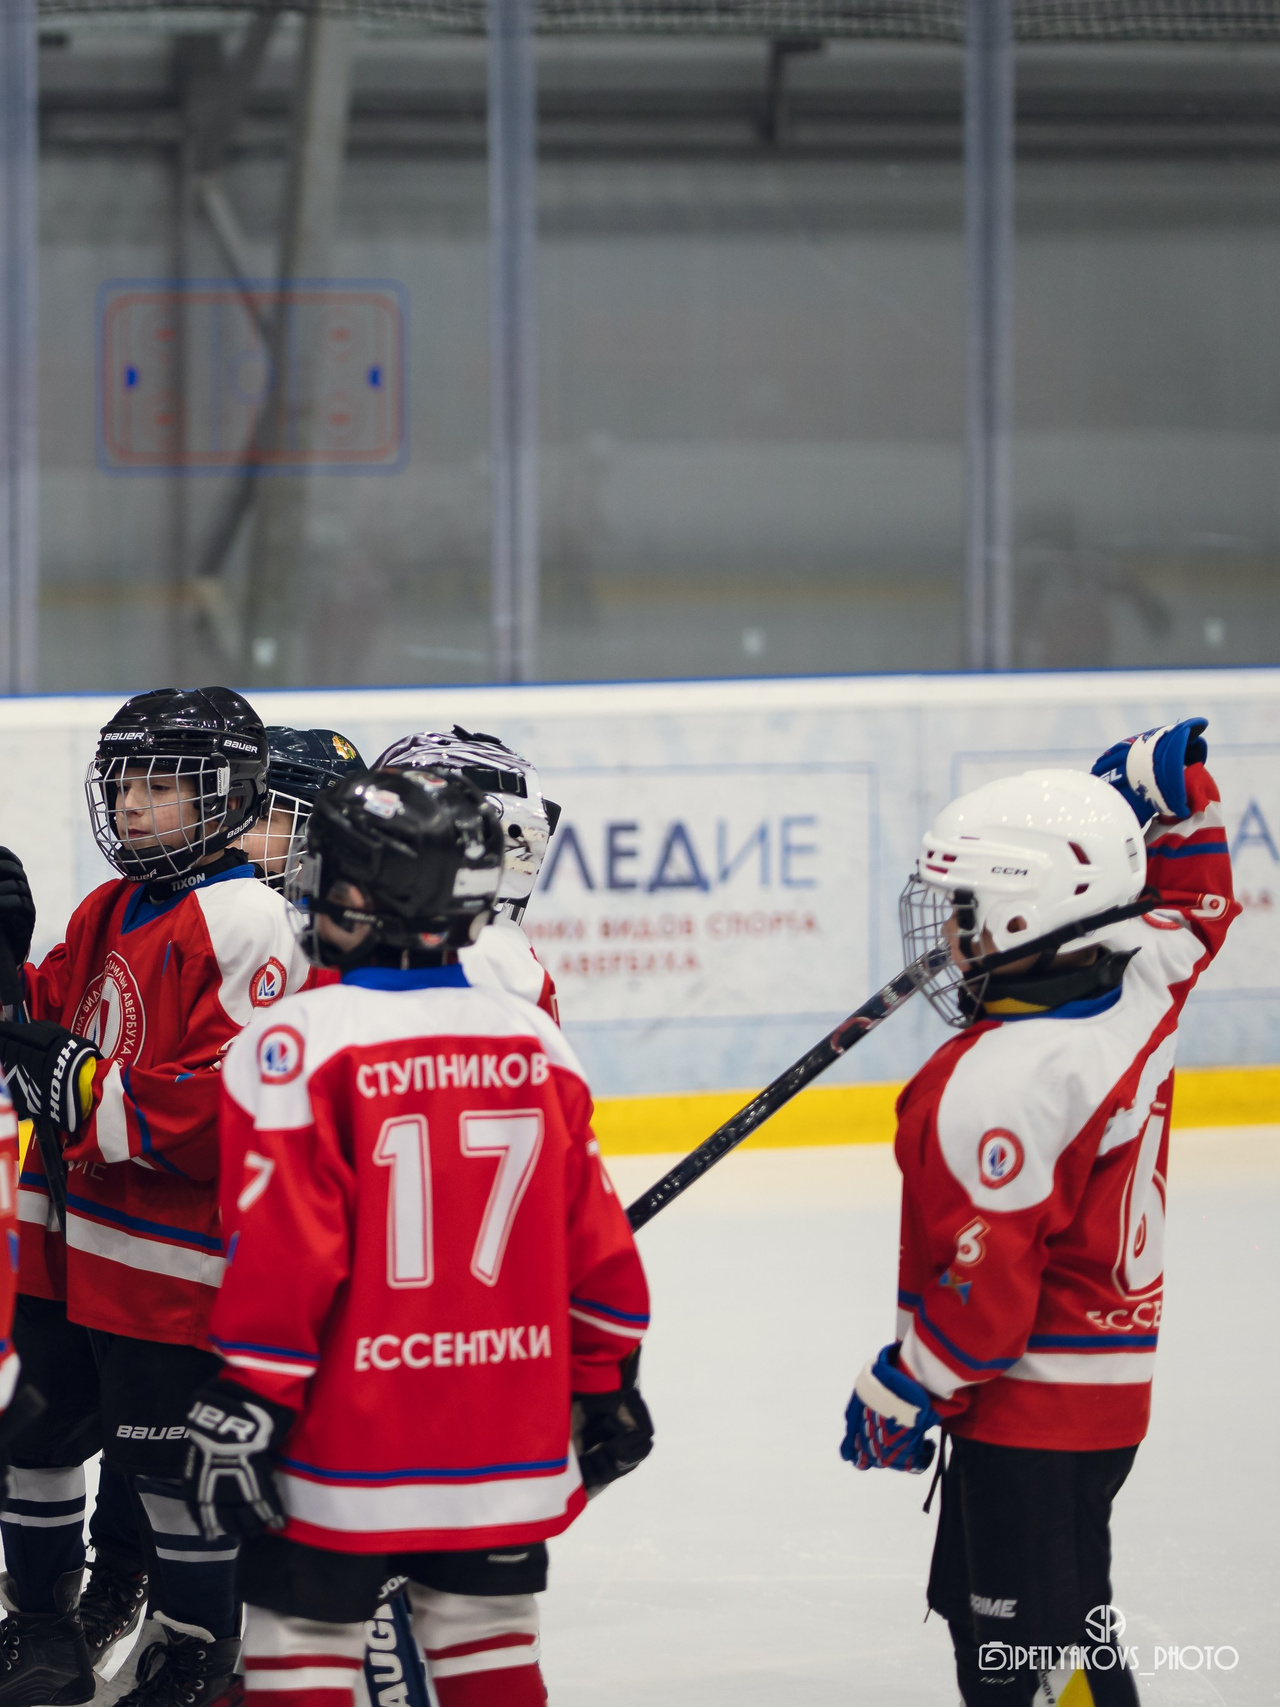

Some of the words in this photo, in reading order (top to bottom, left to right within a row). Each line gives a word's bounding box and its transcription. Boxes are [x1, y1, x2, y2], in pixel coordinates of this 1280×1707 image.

[104, 731, 144, 741] BAUER
[223, 739, 258, 754] BAUER
[226, 816, 253, 838] BAUER
[542, 815, 817, 893] ЛЕДИЕ
[991, 866, 1028, 876] CCM
[171, 872, 206, 892] TIXON
[121, 992, 137, 1055] АВЕРБУХА
[357, 1053, 549, 1098] СТУПНИКОВ
[237, 1151, 275, 1212] 7
[373, 1109, 544, 1289] 17
[954, 1215, 991, 1267] 6
[355, 1325, 551, 1371] ЕССЕНТУКИ
